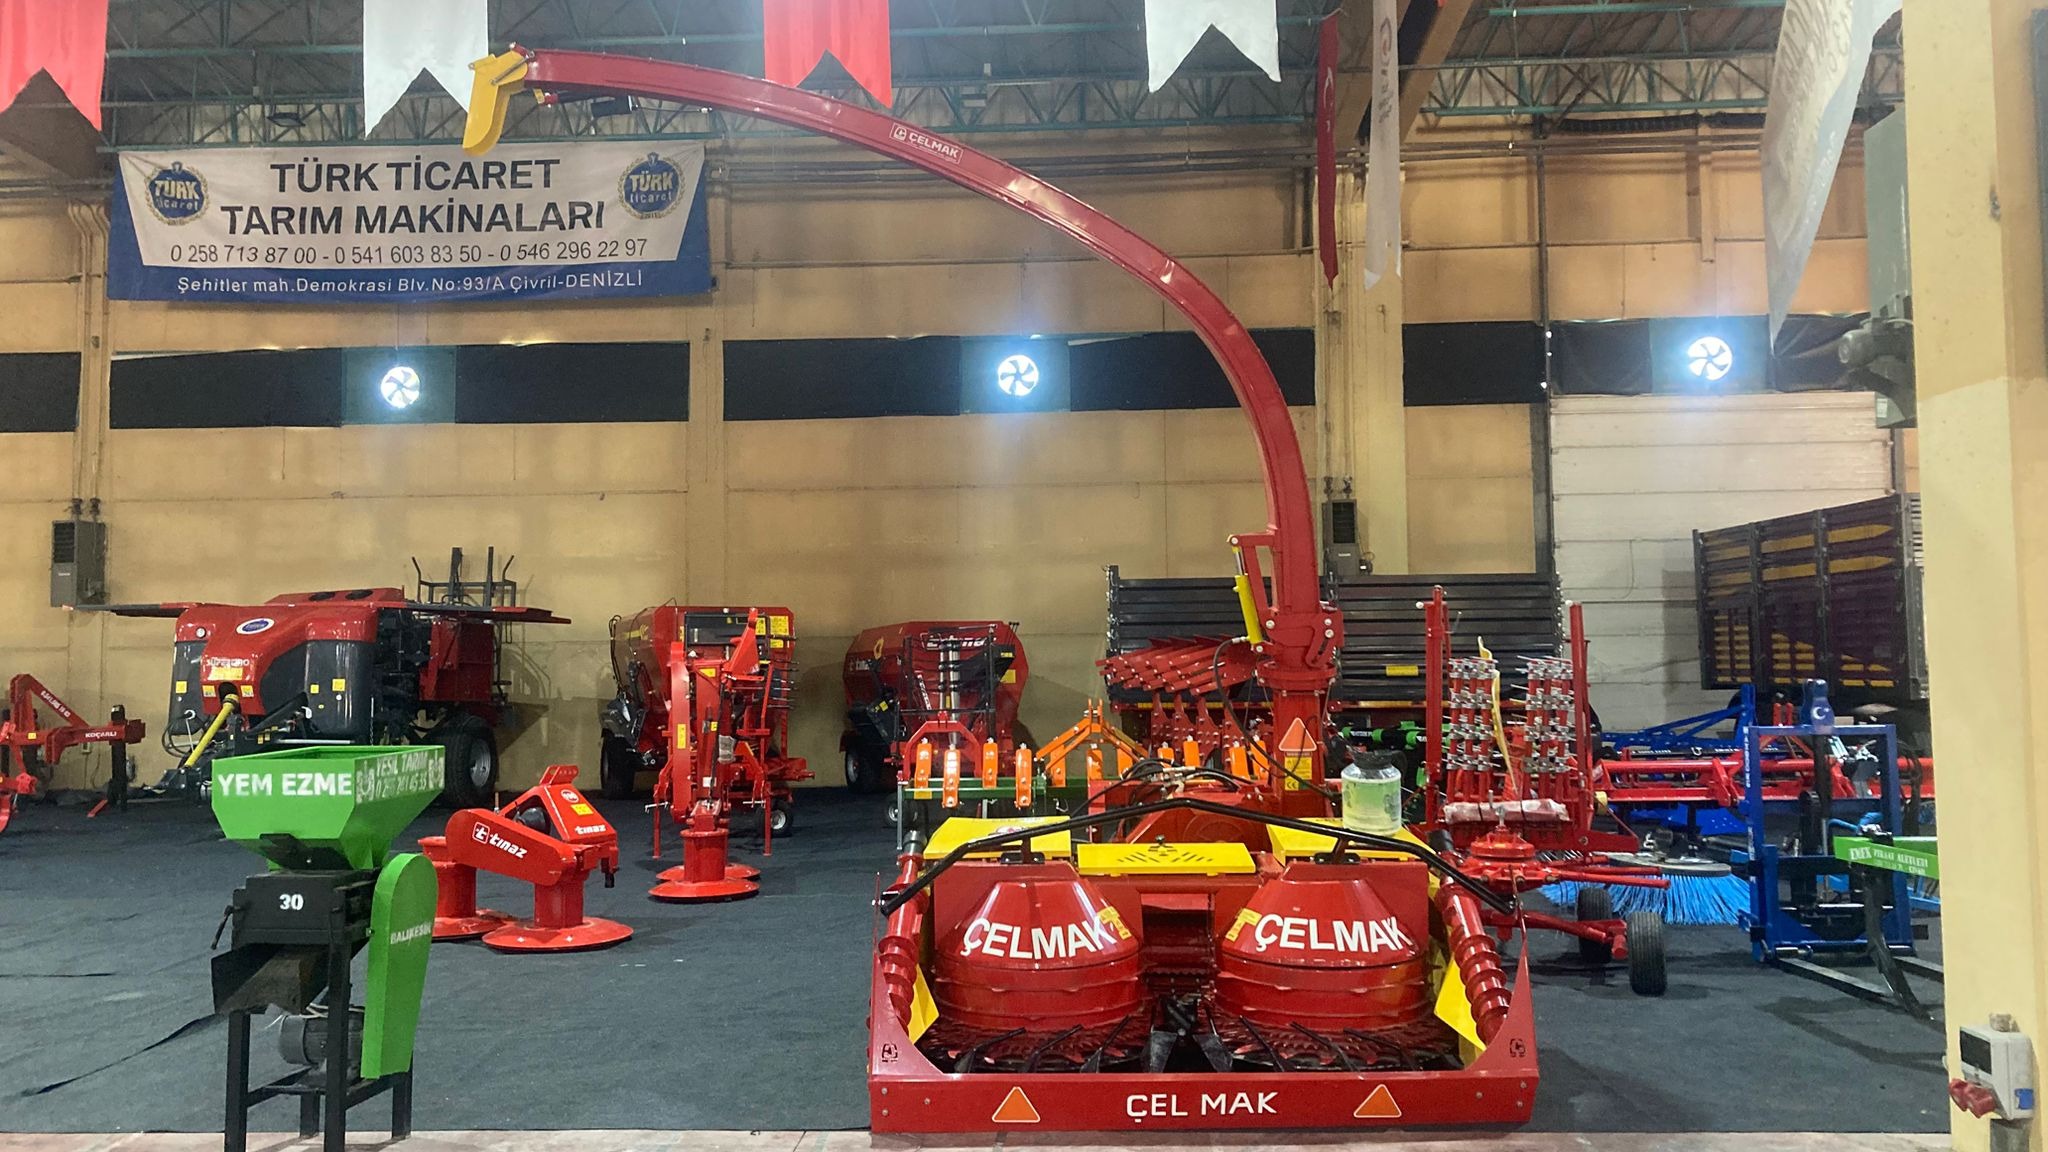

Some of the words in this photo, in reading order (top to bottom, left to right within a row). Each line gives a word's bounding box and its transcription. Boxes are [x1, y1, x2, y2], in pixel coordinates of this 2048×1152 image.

[909, 132, 959, 158] ÇELMAK
[270, 157, 379, 192] TÜRK
[386, 155, 560, 191] TİCARET
[629, 171, 673, 193] TÜRK
[154, 177, 199, 200] TÜRK
[220, 205, 343, 235] TARIM
[354, 198, 605, 234] MAKİNALARI
[170, 244, 182, 263] 0
[188, 245, 218, 263] 258
[224, 245, 258, 263] 713
[265, 247, 288, 264] 87
[294, 247, 317, 264] 00
[334, 246, 346, 264] 0
[352, 246, 382, 264] 541
[391, 246, 424, 264] 603
[430, 245, 453, 263] 83
[459, 245, 481, 262] 50
[500, 244, 511, 261] 0
[516, 243, 550, 261] 546
[556, 241, 591, 259] 296
[597, 240, 619, 258] 22
[625, 238, 648, 257] 97
[178, 277, 248, 294] Şehitler
[398, 277, 504, 292] Blv.No:93/A
[510, 269, 643, 294] Çivril-DENİZLİ
[218, 773, 273, 797] YEM
[281, 772, 353, 796] EZME
[279, 894, 304, 911] 30
[960, 916, 1118, 960] ÇELMAK
[1253, 913, 1414, 953] ÇELMAK
[1126, 1093, 1189, 1123] ÇEL
[1200, 1091, 1279, 1116] MAK
